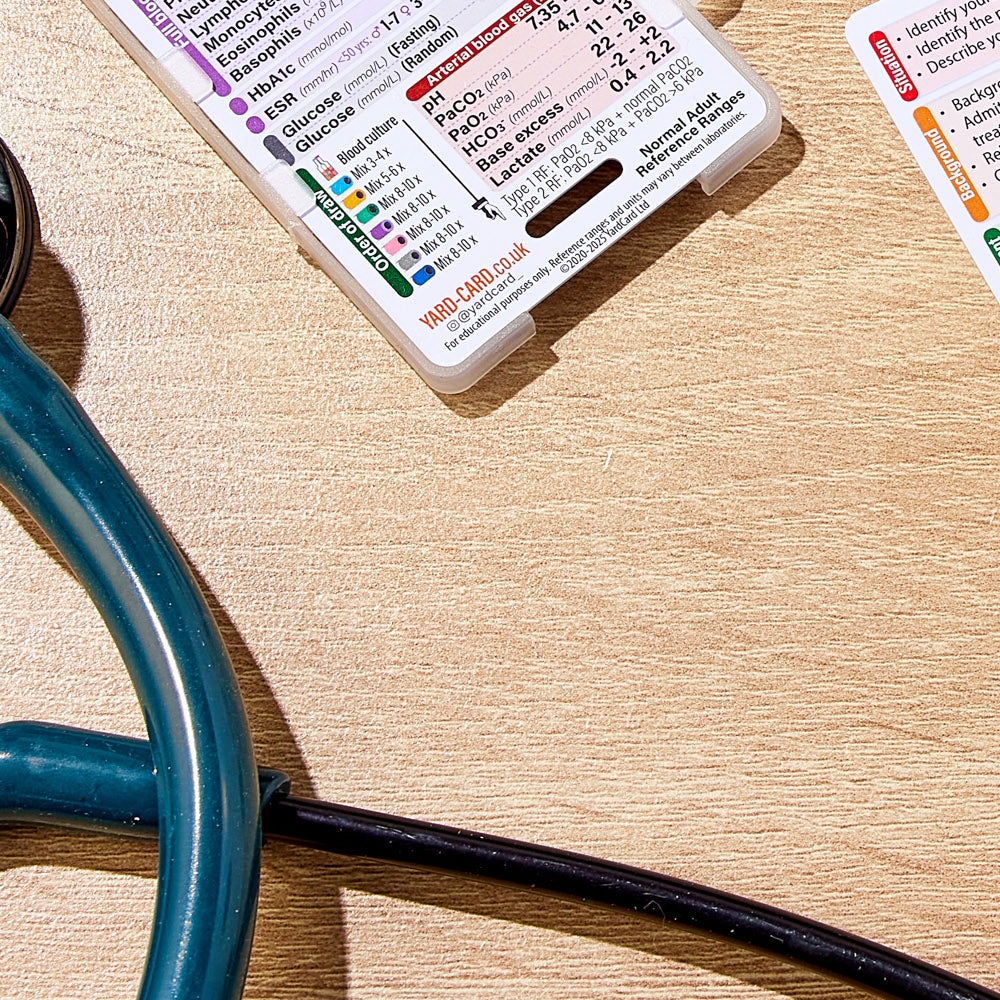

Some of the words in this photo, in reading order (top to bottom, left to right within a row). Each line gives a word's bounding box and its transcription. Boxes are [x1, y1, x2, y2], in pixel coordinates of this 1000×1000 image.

[161, 22, 190, 50] Full
[426, 45, 474, 88] Arterial
[470, 18, 511, 52] blood
[508, 2, 533, 25] gas
[905, 7, 958, 39] Identify
[229, 26, 302, 83] Basophils
[247, 64, 296, 102] HbA1c
[298, 21, 353, 68] (mmol/mol)
[282, 91, 342, 138] Glucose
[344, 56, 388, 95] (mmol/L)
[387, 14, 441, 59] (Fasting)
[421, 90, 446, 115] pH
[525, 0, 561, 30] 7.35
[875, 38, 913, 94] Situation
[925, 40, 986, 74] Describe
[336, 138, 367, 165] Blood
[364, 116, 399, 145] culture
[635, 127, 699, 178] Reference
[697, 90, 746, 129] Ranges
[639, 117, 687, 158] Normal
[686, 92, 721, 123] Adult
[923, 128, 975, 202] Background
[314, 189, 345, 220] draw
[339, 220, 357, 235] of
[444, 337, 459, 351] For
[458, 303, 502, 341] educational
[499, 279, 534, 310] purposes
[532, 266, 552, 283] only.
[548, 238, 586, 269] Reference
[584, 218, 611, 241] ranges
[608, 205, 625, 222] and
[622, 192, 643, 210] units
[640, 180, 659, 196] may
[656, 167, 675, 183] vary
[670, 143, 705, 171] between
[701, 111, 748, 147] laboratories.
[354, 235, 389, 272] Order
[418, 242, 531, 330] YARD-CARD.co.uk
